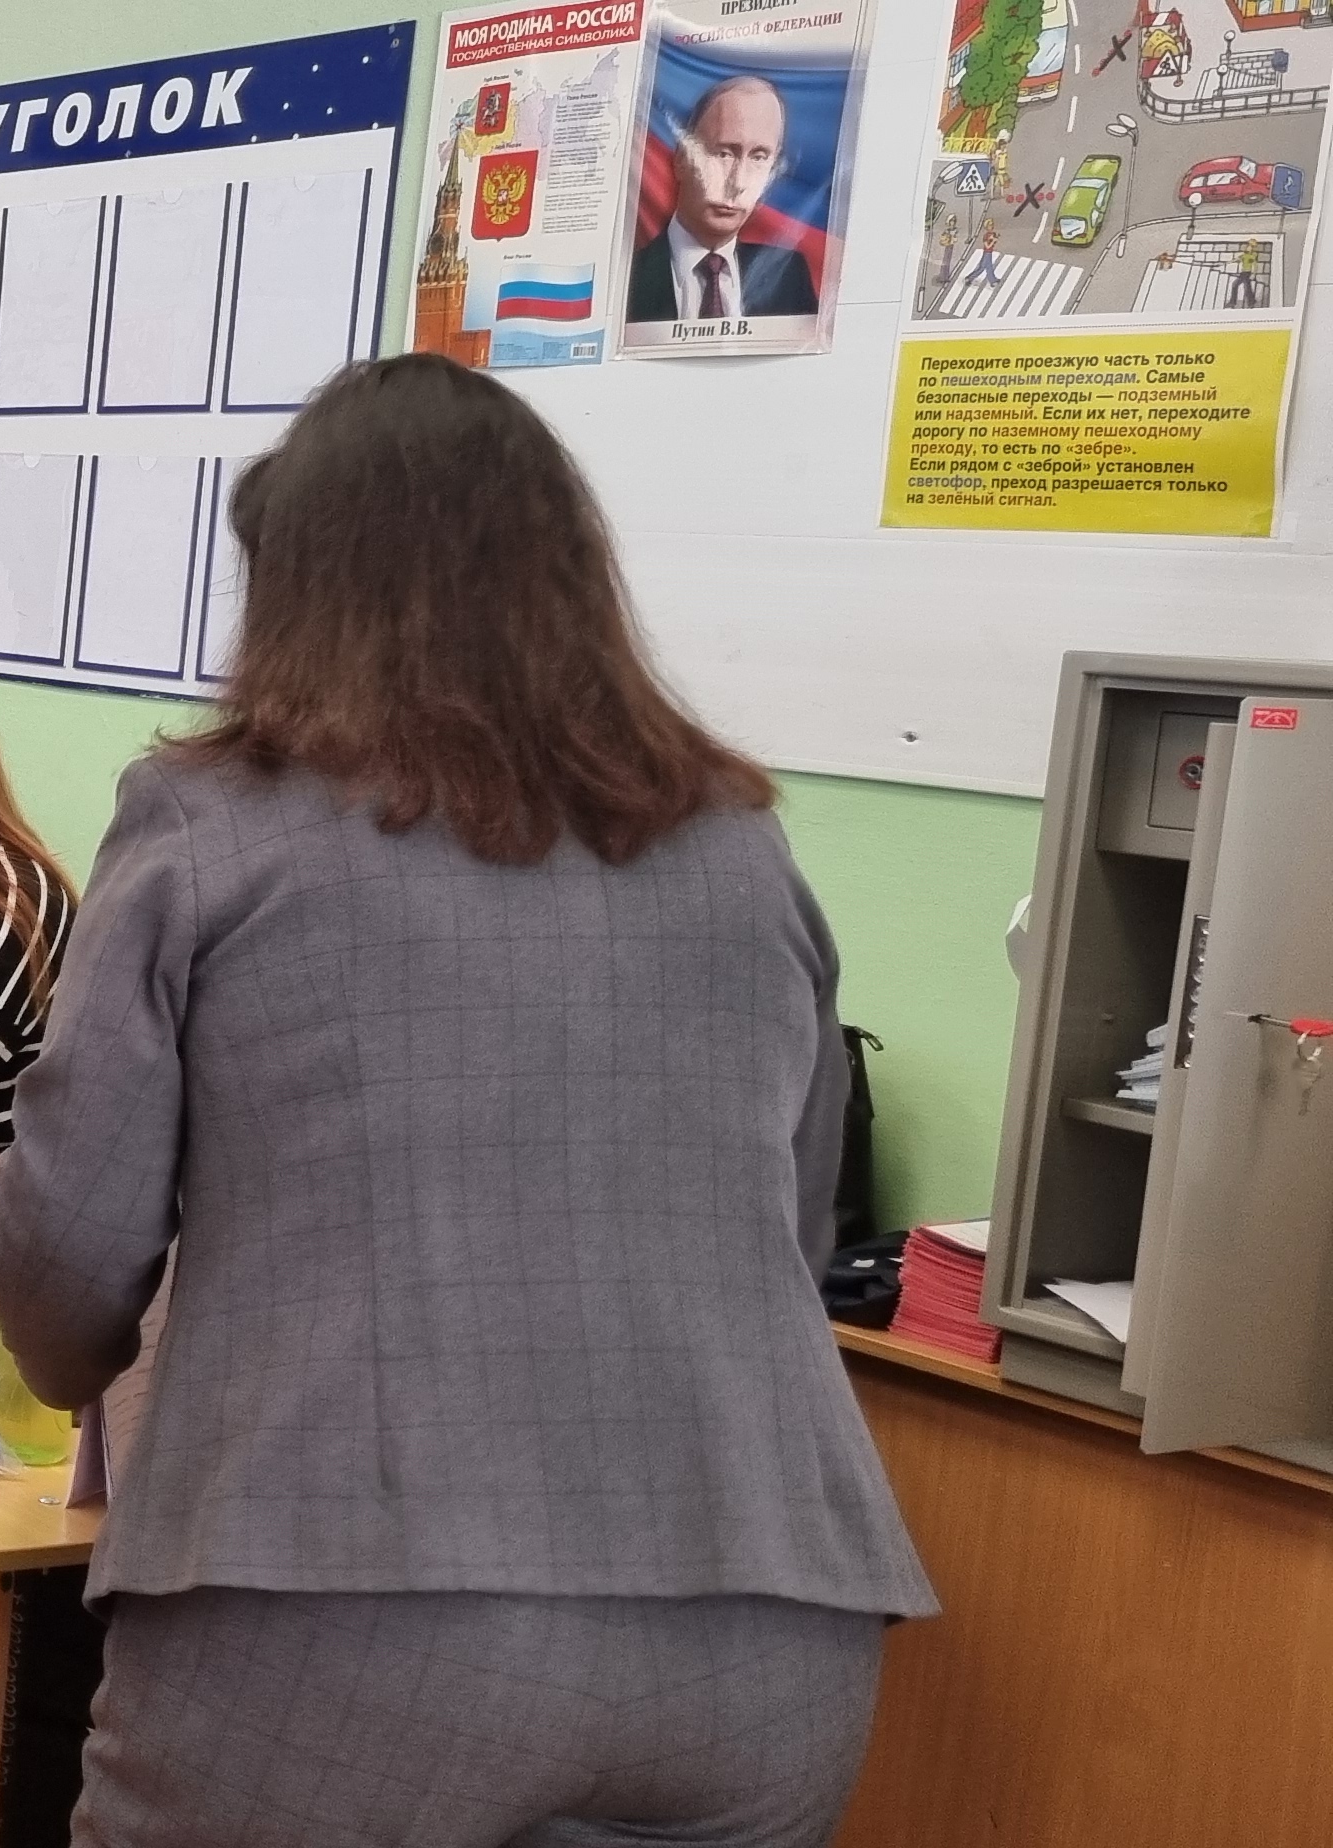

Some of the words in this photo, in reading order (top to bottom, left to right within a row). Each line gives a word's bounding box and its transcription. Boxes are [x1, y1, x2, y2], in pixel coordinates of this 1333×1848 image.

[720, 0, 797, 16] ПРЕЗИДЕ
[455, 25, 488, 48] МОЯ
[489, 14, 553, 44] РОДИНА
[565, 2, 635, 31] РОССИЯ
[675, 21, 761, 45] РОССИЙСКОЙ
[763, 11, 843, 34] ФЕДЕРАЦИИ
[451, 37, 552, 63] ГОСУДАРСТВЕННАЯ
[555, 25, 634, 46] СИМВОЛИКА
[671, 323, 716, 342] Путин
[719, 320, 753, 337] В.В.
[921, 356, 1011, 373] Переходите
[1014, 355, 1099, 371] проезжую
[1104, 355, 1150, 368] часть
[1154, 353, 1215, 366] только
[918, 377, 937, 388] по
[940, 373, 1042, 389] пешеходным
[1046, 371, 1141, 388] переходам.
[1146, 369, 1205, 384] Самые
[916, 391, 1008, 404] безопасные
[1012, 392, 1092, 406] переходы
[1118, 385, 1217, 404] подземный
[914, 409, 942, 421] или
[945, 406, 1038, 422] надземный.
[1042, 406, 1083, 420] Если
[1086, 408, 1106, 420] их
[1110, 408, 1143, 422] нет,
[1147, 406, 1251, 423] переходите
[912, 426, 964, 440] дорогу
[968, 426, 987, 438] по
[991, 425, 1080, 441] наземному
[1083, 425, 1202, 441] пешеходному
[911, 442, 977, 457] преходу,
[982, 443, 998, 455] то
[1002, 443, 1037, 455] есть
[1041, 443, 1061, 455] по
[1066, 442, 1137, 458] «зебре».
[909, 458, 946, 471] Если
[949, 459, 998, 474] рядом
[1003, 461, 1012, 472] с
[1016, 458, 1090, 475] «зеброй»
[1096, 460, 1194, 476] установлен
[907, 474, 986, 491] светофор,
[991, 477, 1047, 491] преход
[1052, 478, 1162, 494] разрешается
[1167, 478, 1228, 493] только
[906, 493, 923, 504] на
[927, 491, 994, 506] зелёный
[998, 493, 1057, 507] сигнал.
